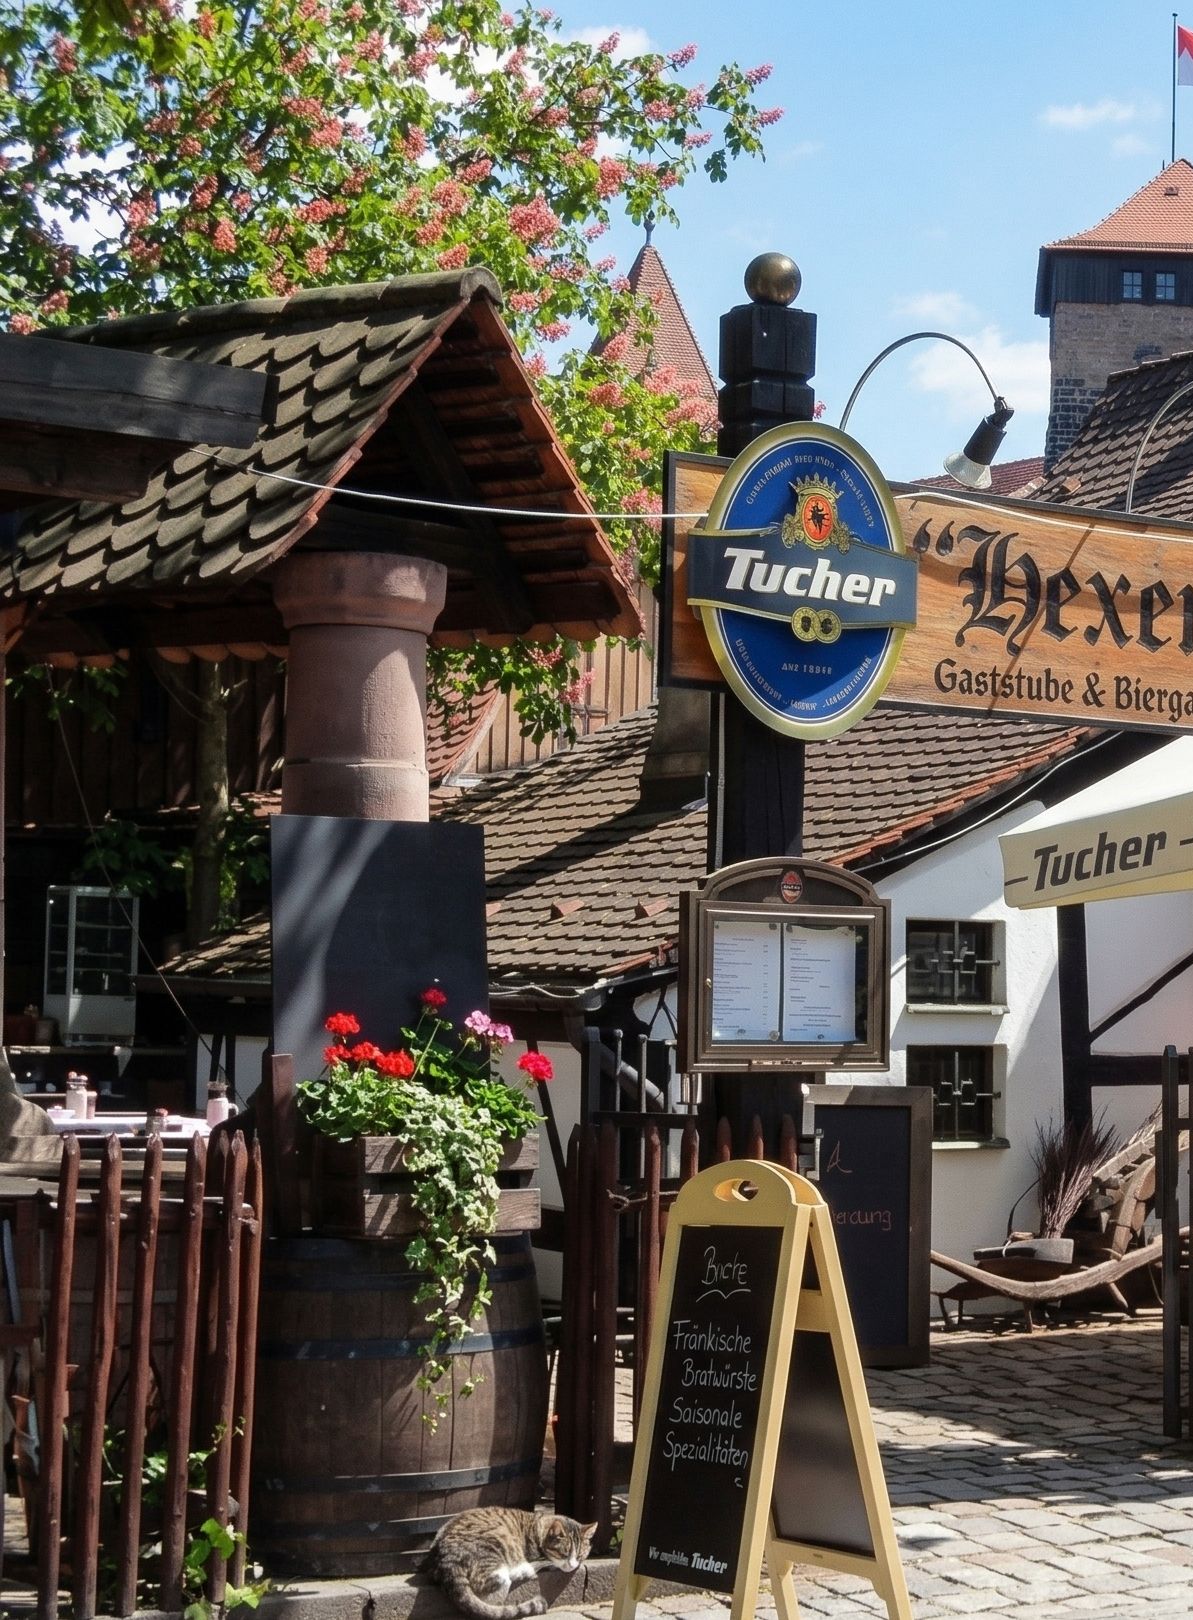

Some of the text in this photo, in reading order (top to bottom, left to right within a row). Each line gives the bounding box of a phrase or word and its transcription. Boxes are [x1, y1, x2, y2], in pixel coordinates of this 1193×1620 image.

[724, 547, 896, 607] Tucher
[934, 658, 1074, 704] Gaststube
[1082, 671, 1106, 708] &
[1033, 831, 1167, 892] Tucher
[673, 1320, 752, 1354] Fränkische
[681, 1358, 757, 1391] Bratwürste
[668, 1396, 743, 1428] Saisonale
[662, 1430, 749, 1472] Spezialitäten
[691, 1552, 728, 1574] Tucher
